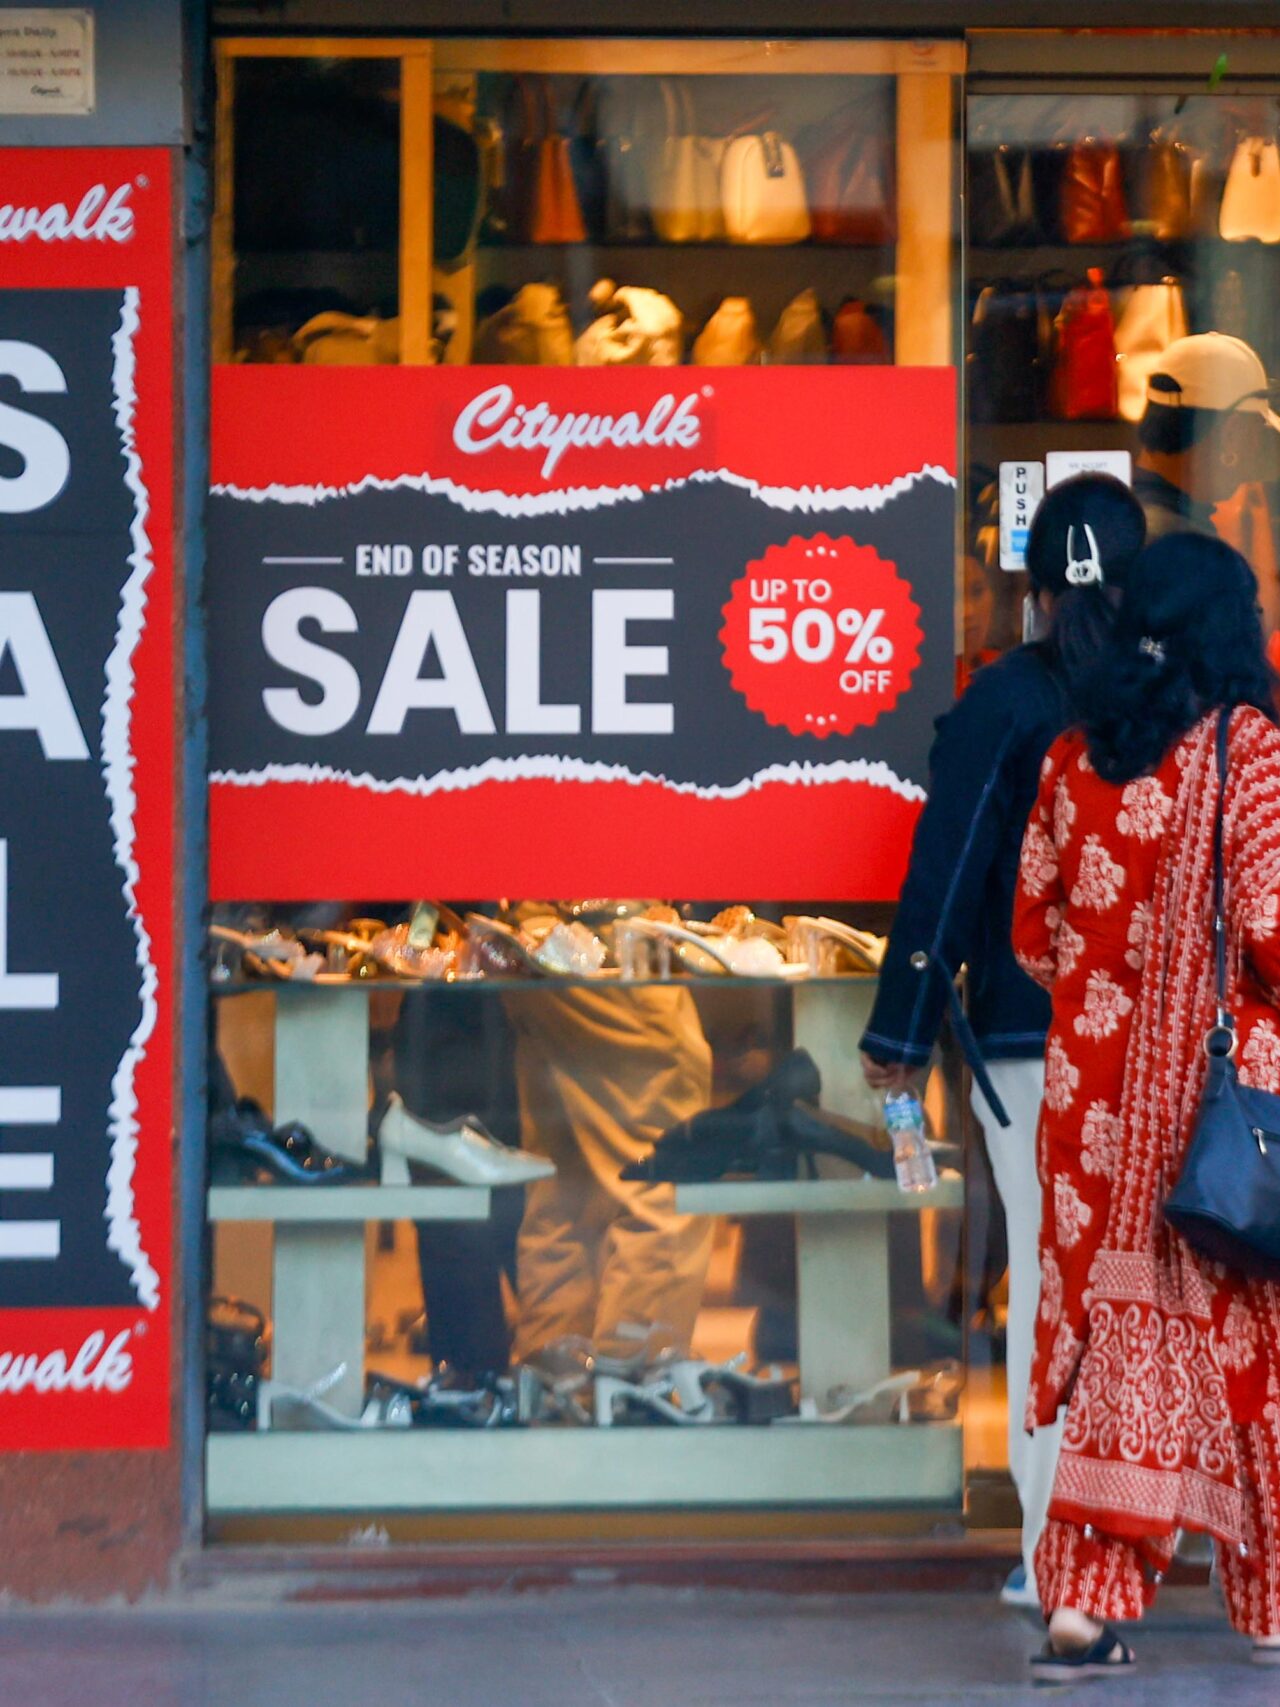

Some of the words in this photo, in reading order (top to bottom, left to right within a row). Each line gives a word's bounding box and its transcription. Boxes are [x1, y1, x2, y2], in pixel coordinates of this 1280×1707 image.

[452, 384, 701, 479] Citywalk
[1015, 466, 1027, 526] PUSH
[355, 544, 413, 577] END
[422, 544, 459, 577] OF
[467, 544, 582, 577] SEASON
[750, 578, 788, 603] UP
[792, 578, 833, 604] TO
[262, 586, 675, 736] SALE
[748, 607, 894, 664] 50%
[839, 669, 892, 694] OFF
